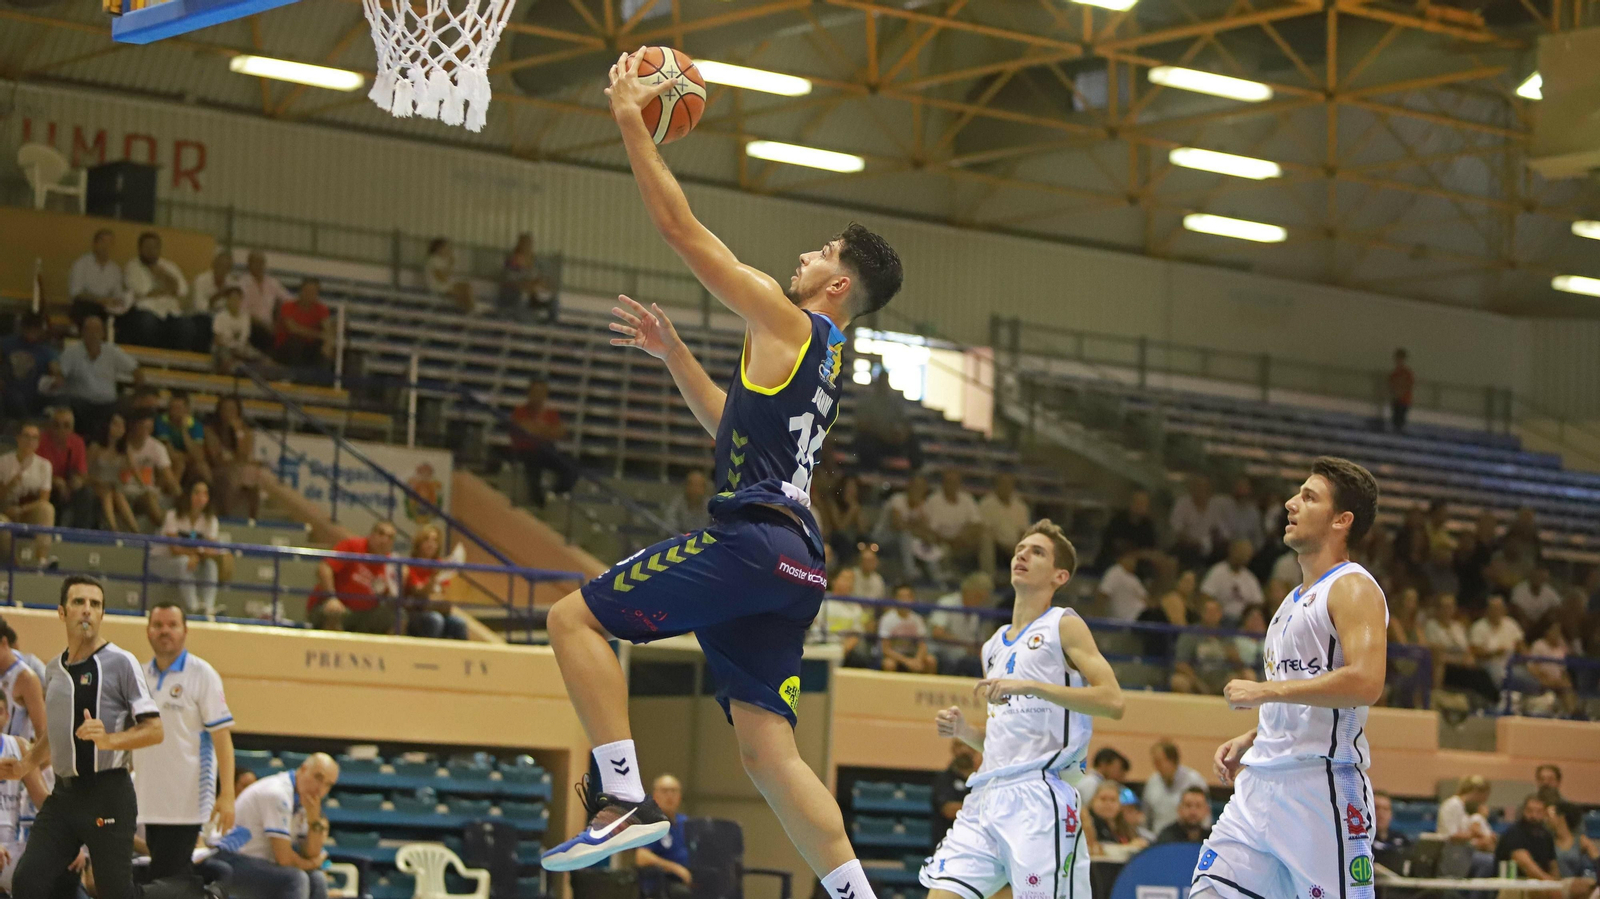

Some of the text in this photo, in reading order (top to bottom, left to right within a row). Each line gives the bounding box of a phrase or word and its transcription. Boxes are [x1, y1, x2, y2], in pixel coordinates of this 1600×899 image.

[779, 562, 807, 580] master
[305, 650, 386, 673] PRENSA
[465, 659, 488, 676] TV
[1005, 652, 1017, 674] 4
[1197, 849, 1218, 871] 8
